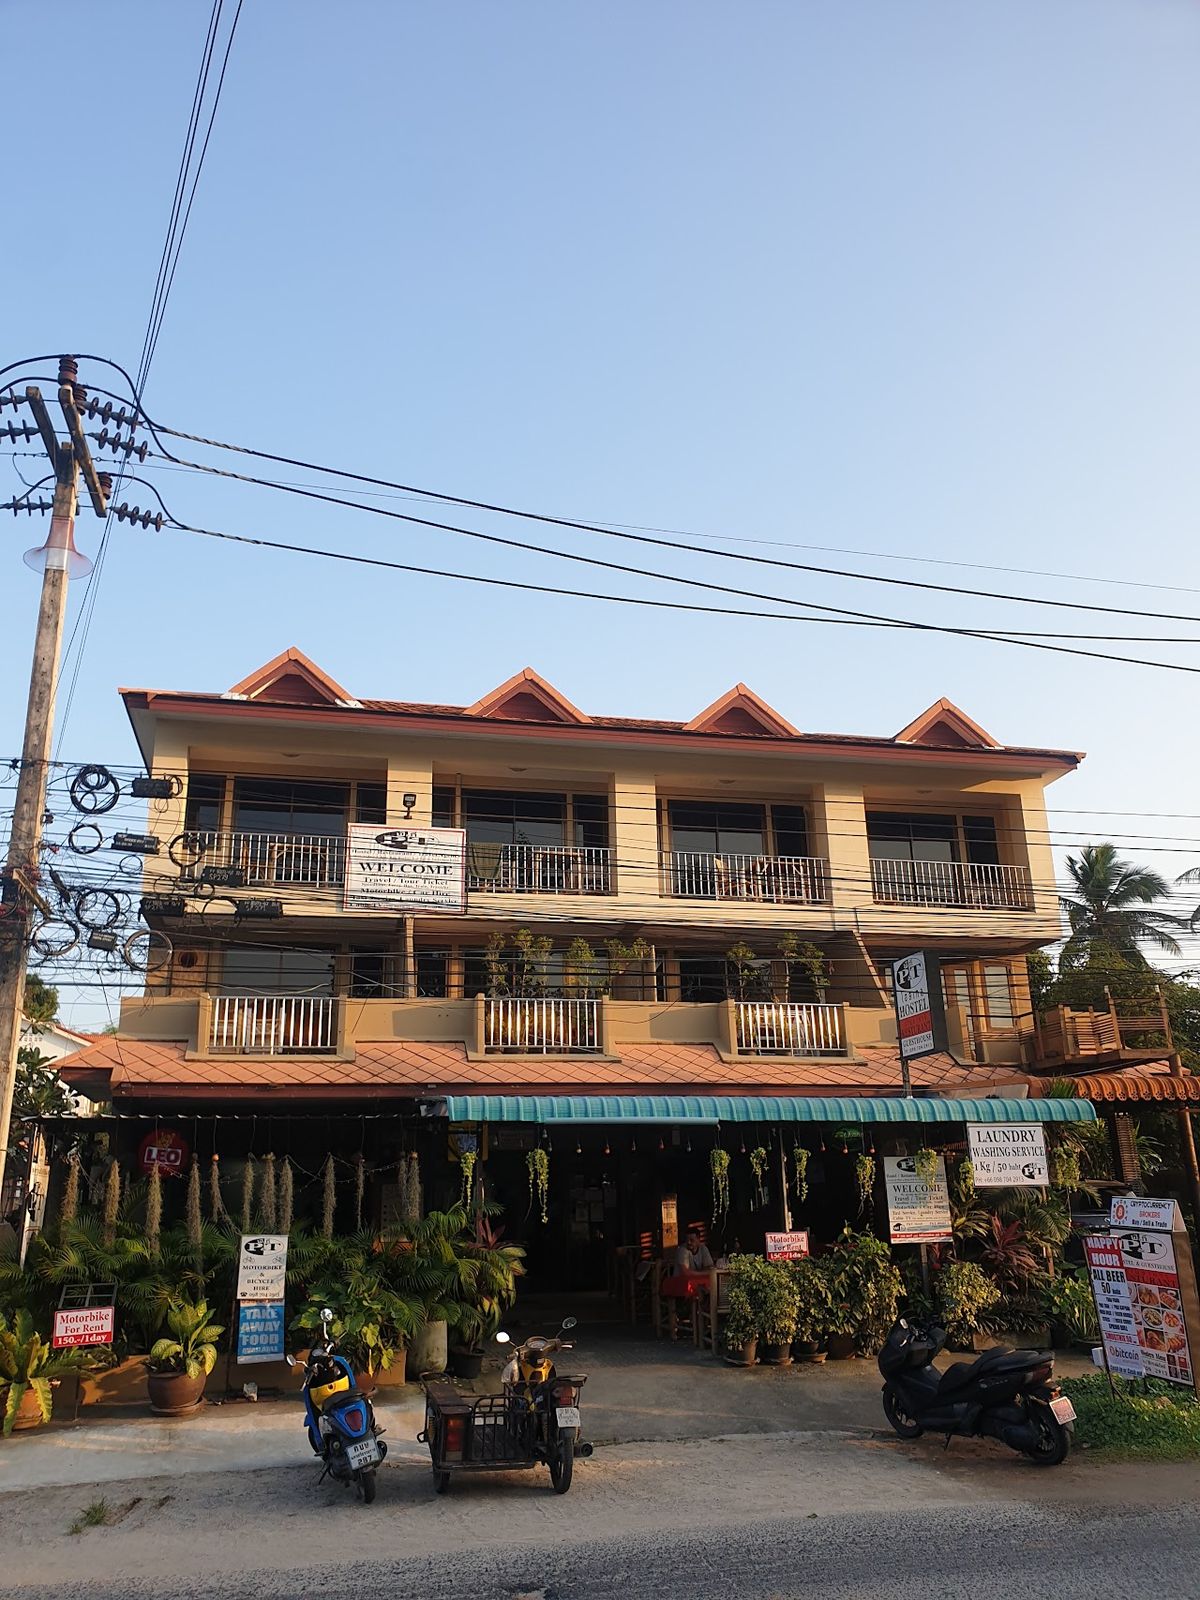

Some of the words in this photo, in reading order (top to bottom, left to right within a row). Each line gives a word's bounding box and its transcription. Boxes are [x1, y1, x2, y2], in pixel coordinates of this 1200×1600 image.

[359, 862, 453, 876] WELCOME
[900, 998, 929, 1019] HOSTEL
[903, 1033, 932, 1047] GUESTHOUSE
[977, 1129, 1036, 1143] LAUNDRY
[146, 1148, 180, 1164] LEO
[972, 1147, 1011, 1157] WASHING
[1012, 1146, 1045, 1157] SERVICE
[980, 1161, 991, 1174] Kg
[998, 1163, 1008, 1173] 50
[1009, 1163, 1021, 1171] baht
[893, 1184, 944, 1193] WELCOME
[1130, 1200, 1170, 1210] CRYPTOCURRENCY
[769, 1235, 805, 1243] Motorbike
[1087, 1237, 1118, 1250] HAPPY
[1092, 1253, 1119, 1266] HOUR
[1141, 1262, 1174, 1271] GUESTHOUSE
[1092, 1269, 1105, 1280] ALL
[1106, 1271, 1125, 1283] BEER
[1101, 1282, 1111, 1294] 50
[60, 1311, 110, 1324] Motorbike
[245, 1308, 278, 1320] TAKE
[65, 1326, 81, 1334] For
[83, 1323, 104, 1332] Rent
[241, 1320, 281, 1333] AWAY
[58, 1333, 108, 1345] 150.-/1day
[241, 1333, 279, 1346] FOOD
[1115, 1347, 1140, 1360] bitcoin
[357, 1454, 372, 1466] 287
